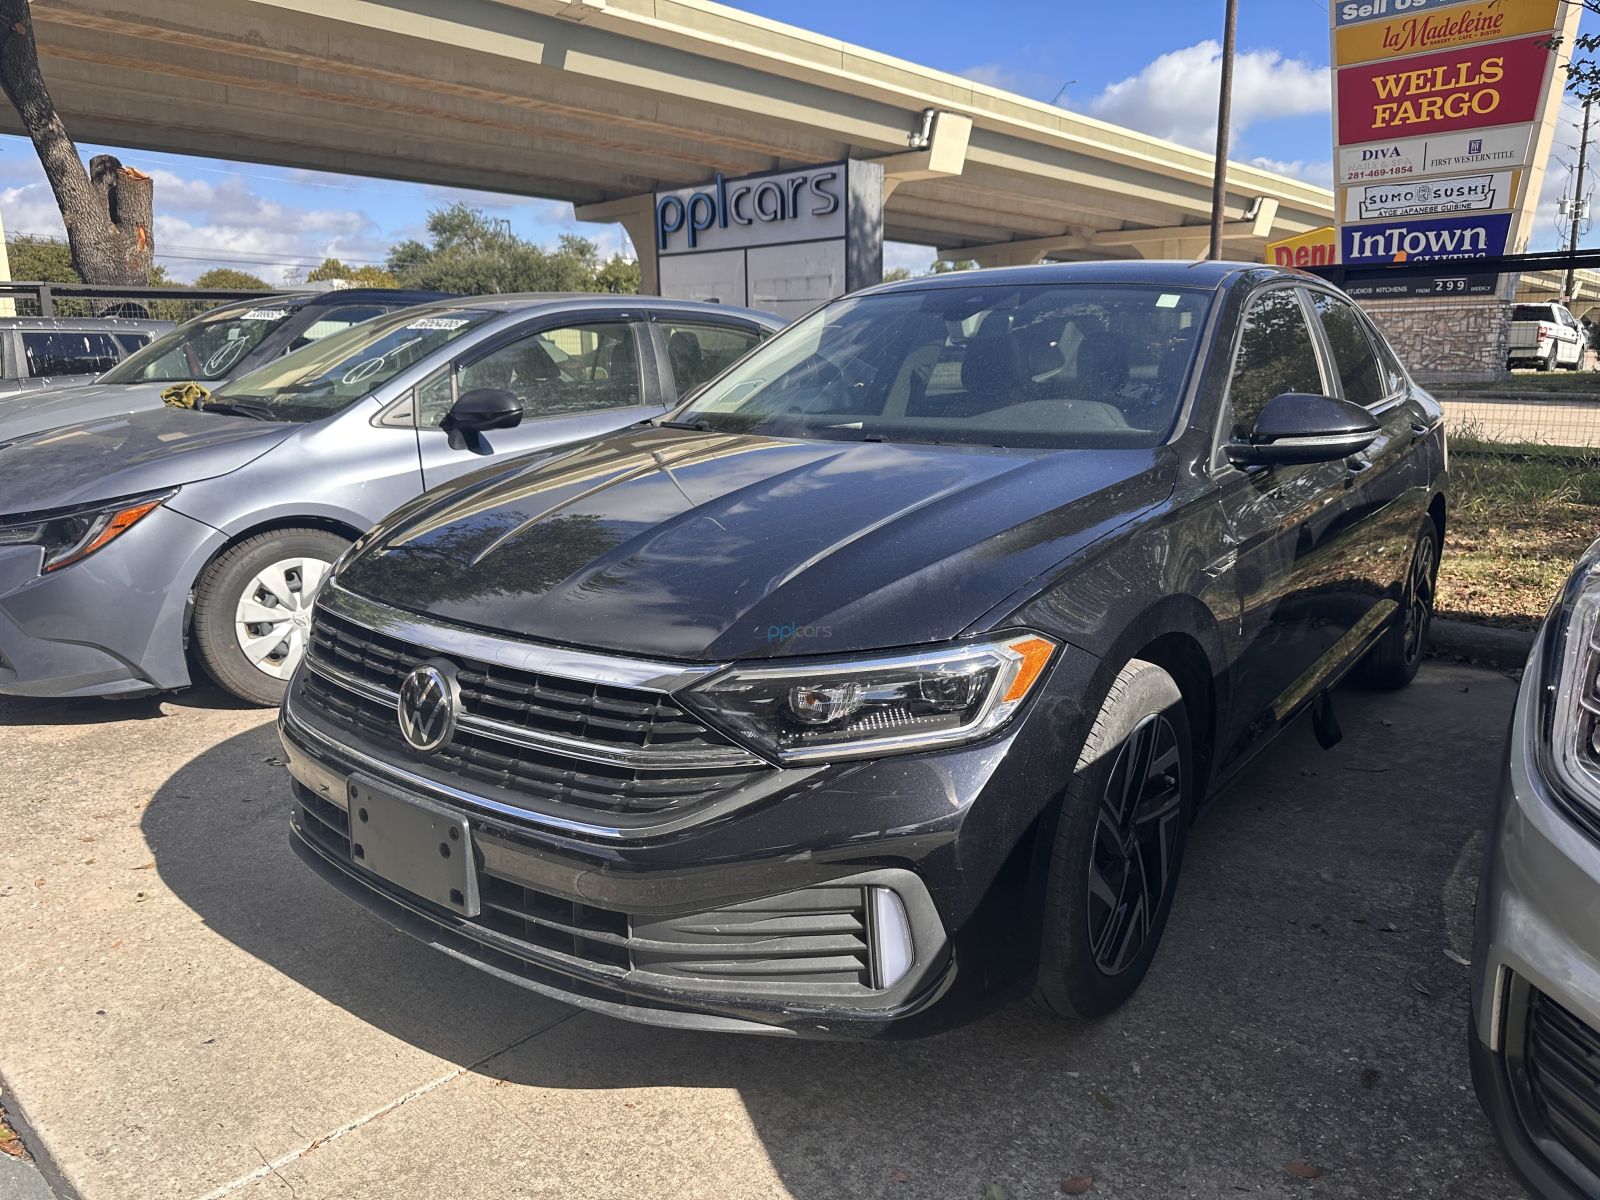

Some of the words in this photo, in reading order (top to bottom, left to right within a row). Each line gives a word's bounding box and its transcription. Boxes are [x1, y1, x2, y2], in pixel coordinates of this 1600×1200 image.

[1342, 0, 1387, 20] Sell
[1383, 26, 1400, 49] la
[1393, 10, 1504, 51] Madeleine
[1430, 37, 1451, 46] BAKERY
[1480, 29, 1501, 37] BISTRO
[1372, 57, 1504, 99] WELLS
[1372, 88, 1500, 128] FARGO
[1361, 146, 1401, 161] DIVA
[1431, 158, 1453, 167] FIRST
[1454, 152, 1491, 164] WESTERN
[1492, 151, 1514, 160] TITLE
[1347, 166, 1413, 180] 281-469-1854
[1369, 191, 1414, 205] SUMO
[1433, 185, 1487, 199] SUSHI
[657, 173, 839, 249] pplcars
[1378, 209, 1398, 217] AYCE
[1400, 205, 1439, 215] JAPANESE
[1440, 203, 1472, 212] CUISINE
[1350, 226, 1487, 258] InTown
[1345, 287, 1373, 295] STUDIOS
[1375, 285, 1408, 293] KITCHENS
[1435, 280, 1465, 291] 299
